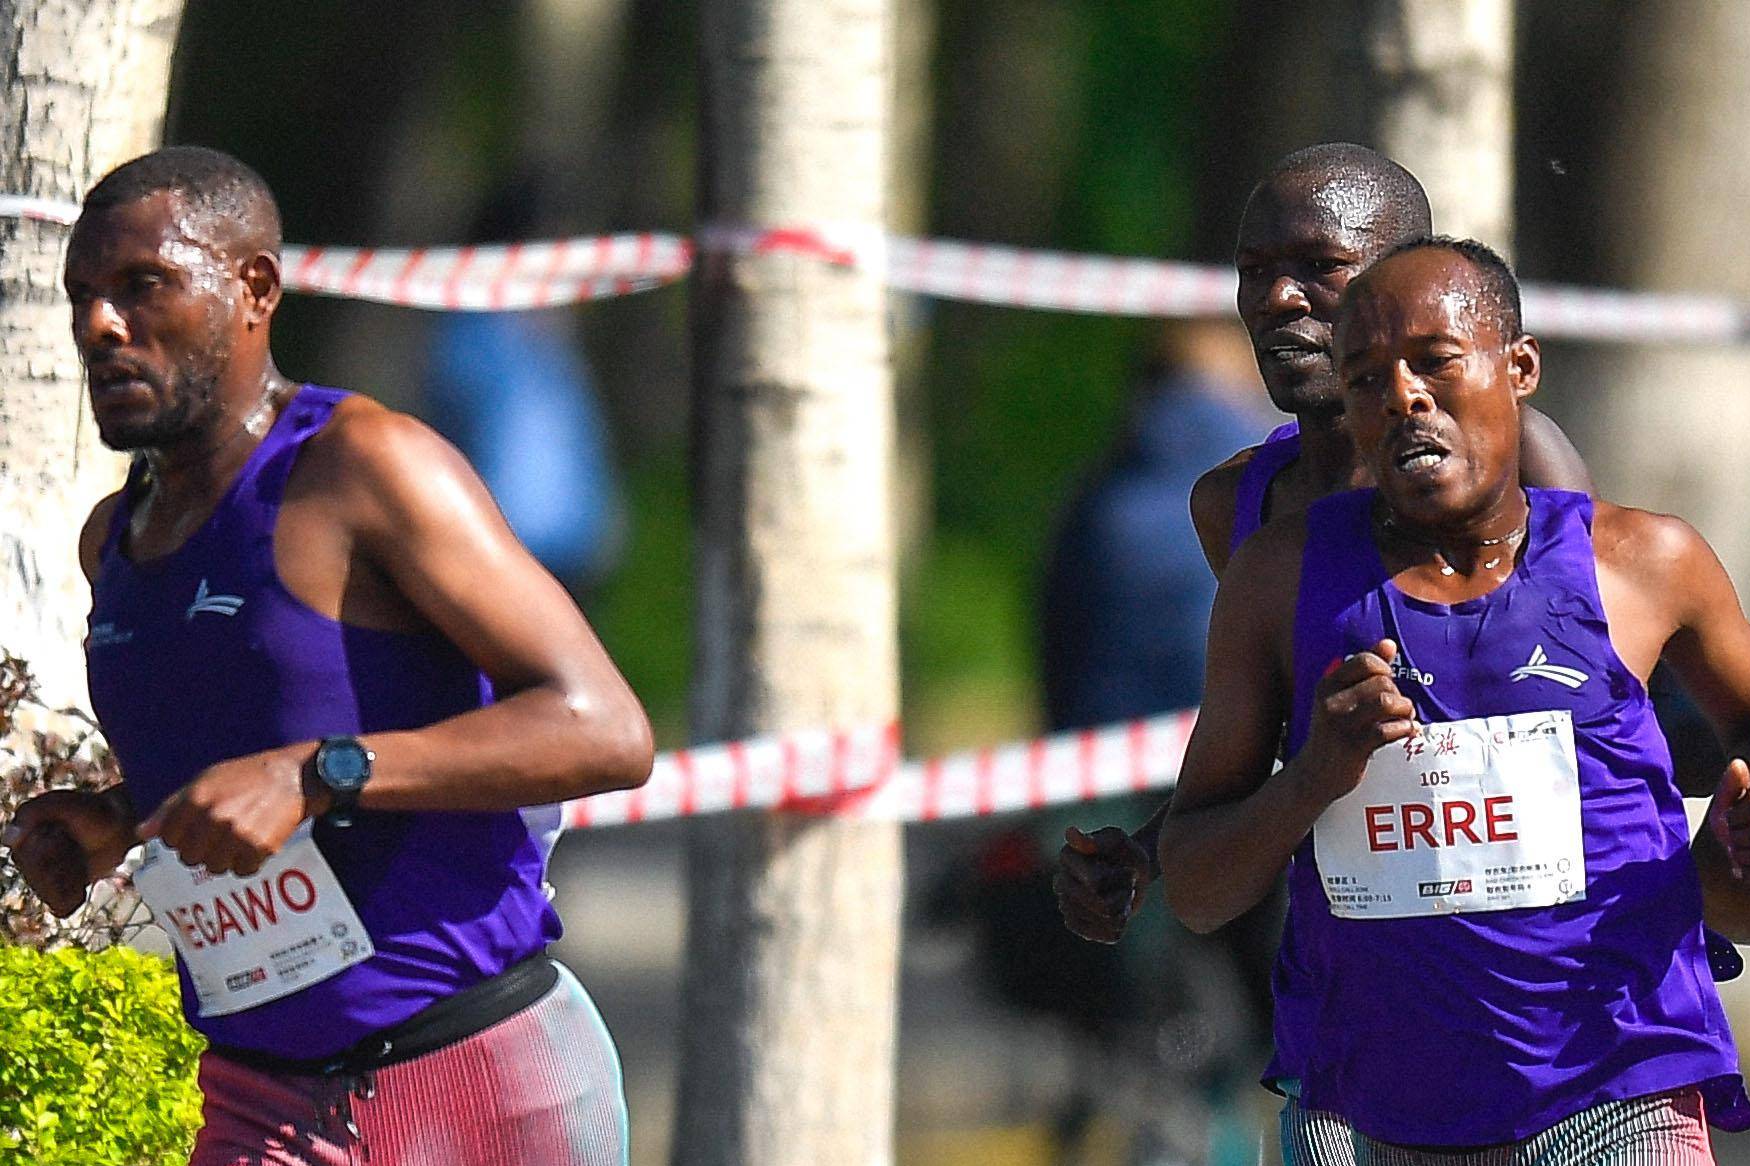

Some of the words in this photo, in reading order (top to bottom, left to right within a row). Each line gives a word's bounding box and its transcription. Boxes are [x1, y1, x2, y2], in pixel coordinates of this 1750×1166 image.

[1419, 770, 1450, 787] 105
[1364, 795, 1519, 853] ERRE
[1422, 883, 1452, 895] BIG
